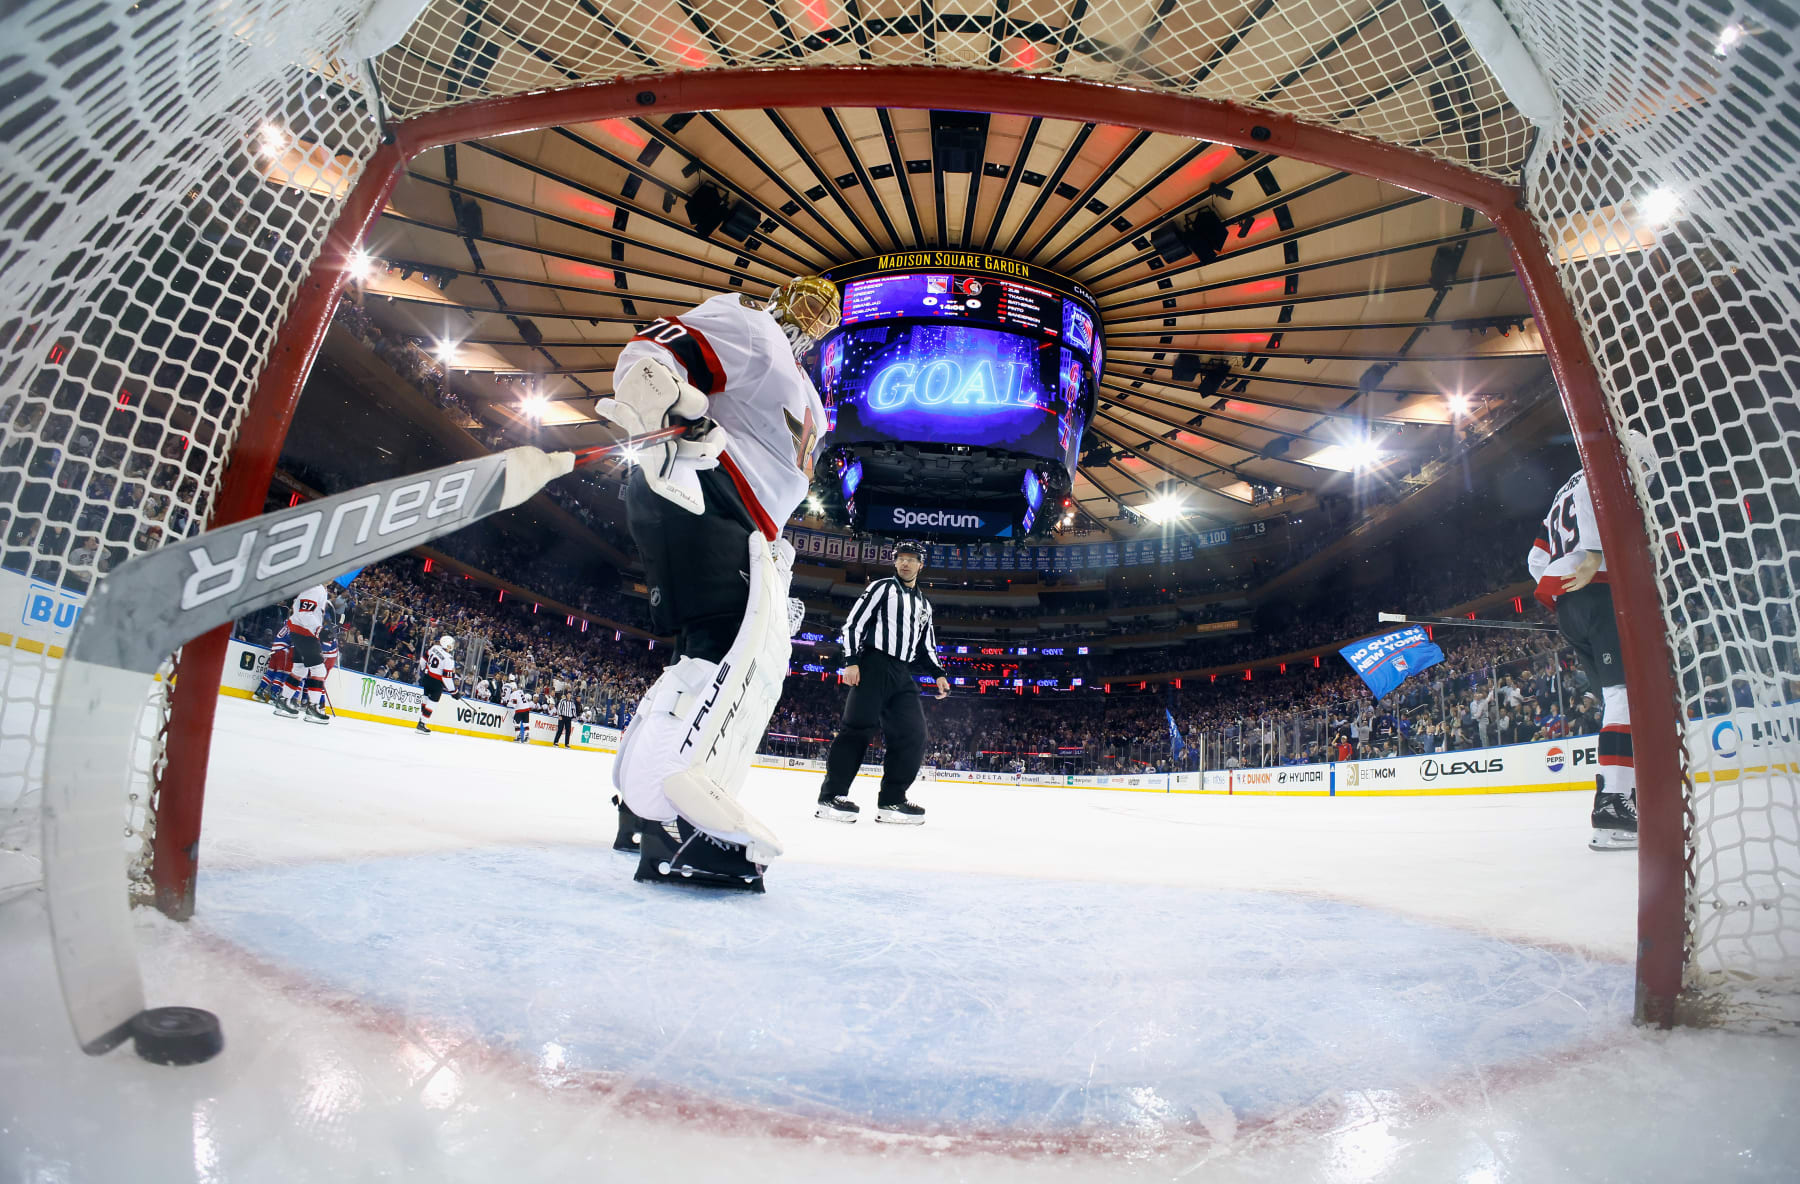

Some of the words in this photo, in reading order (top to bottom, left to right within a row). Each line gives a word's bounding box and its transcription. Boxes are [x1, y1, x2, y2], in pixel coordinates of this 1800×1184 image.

[878, 254, 931, 270] MADISON
[935, 252, 980, 267] SQUARE
[985, 256, 1029, 277] GARDEN
[637, 317, 688, 344] 70
[867, 360, 1037, 410] GOAL
[893, 507, 979, 528] Spectrum
[180, 468, 475, 611] BAUER
[1209, 530, 1227, 545] 100
[1350, 648, 1368, 663] NO
[1368, 632, 1401, 651] QUIT
[1403, 628, 1420, 636] IN
[1357, 648, 1385, 672] NEW
[1384, 633, 1425, 651] YORK
[457, 707, 502, 728] verizon
[680, 661, 731, 755] TRUE
[706, 656, 757, 763] TRUE
[1441, 758, 1503, 775] LEXUS
[1573, 748, 1600, 767] PE
[1289, 771, 1323, 783] HYUNDAI
[1360, 768, 1396, 779] BETMGM
